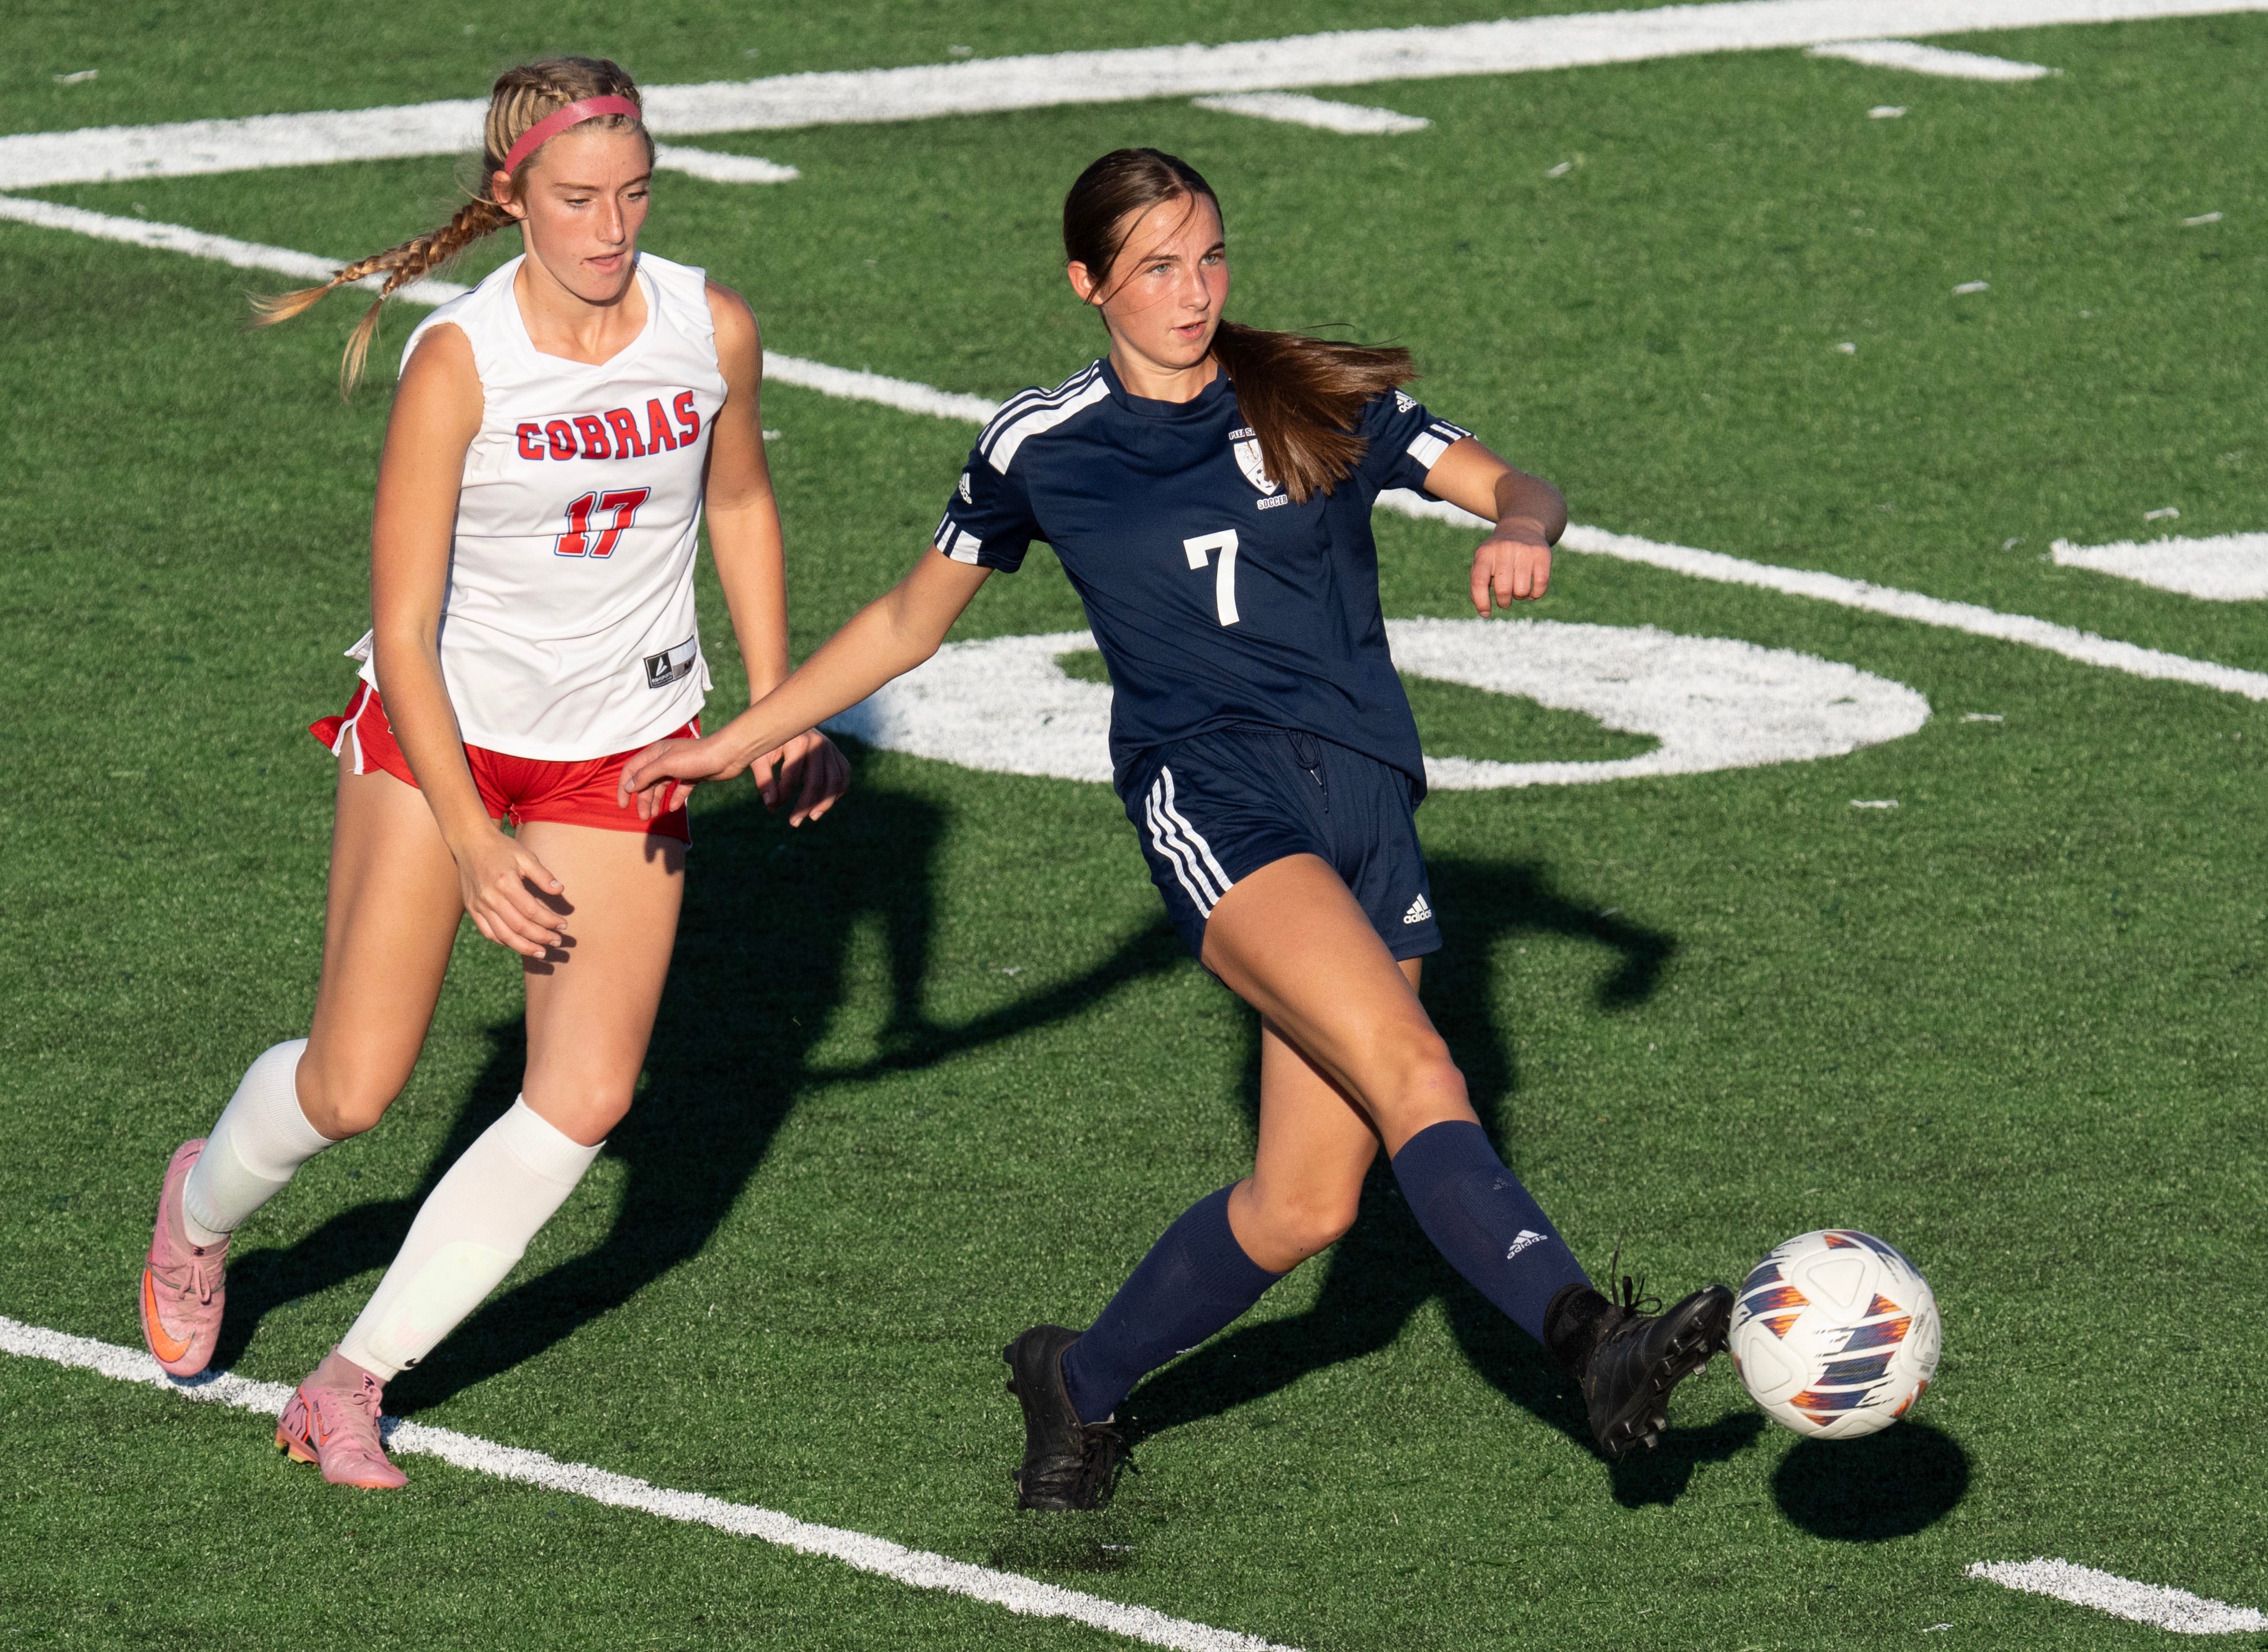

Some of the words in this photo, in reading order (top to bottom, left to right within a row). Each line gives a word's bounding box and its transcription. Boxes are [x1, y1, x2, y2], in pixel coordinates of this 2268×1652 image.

[516, 390, 700, 461] COBRAS
[554, 487, 651, 559] 17
[1257, 494, 1288, 510] SOCCER
[1183, 528, 1240, 626] 7
[1403, 909, 1432, 924] adidas
[1507, 1235, 1548, 1259] adidas
